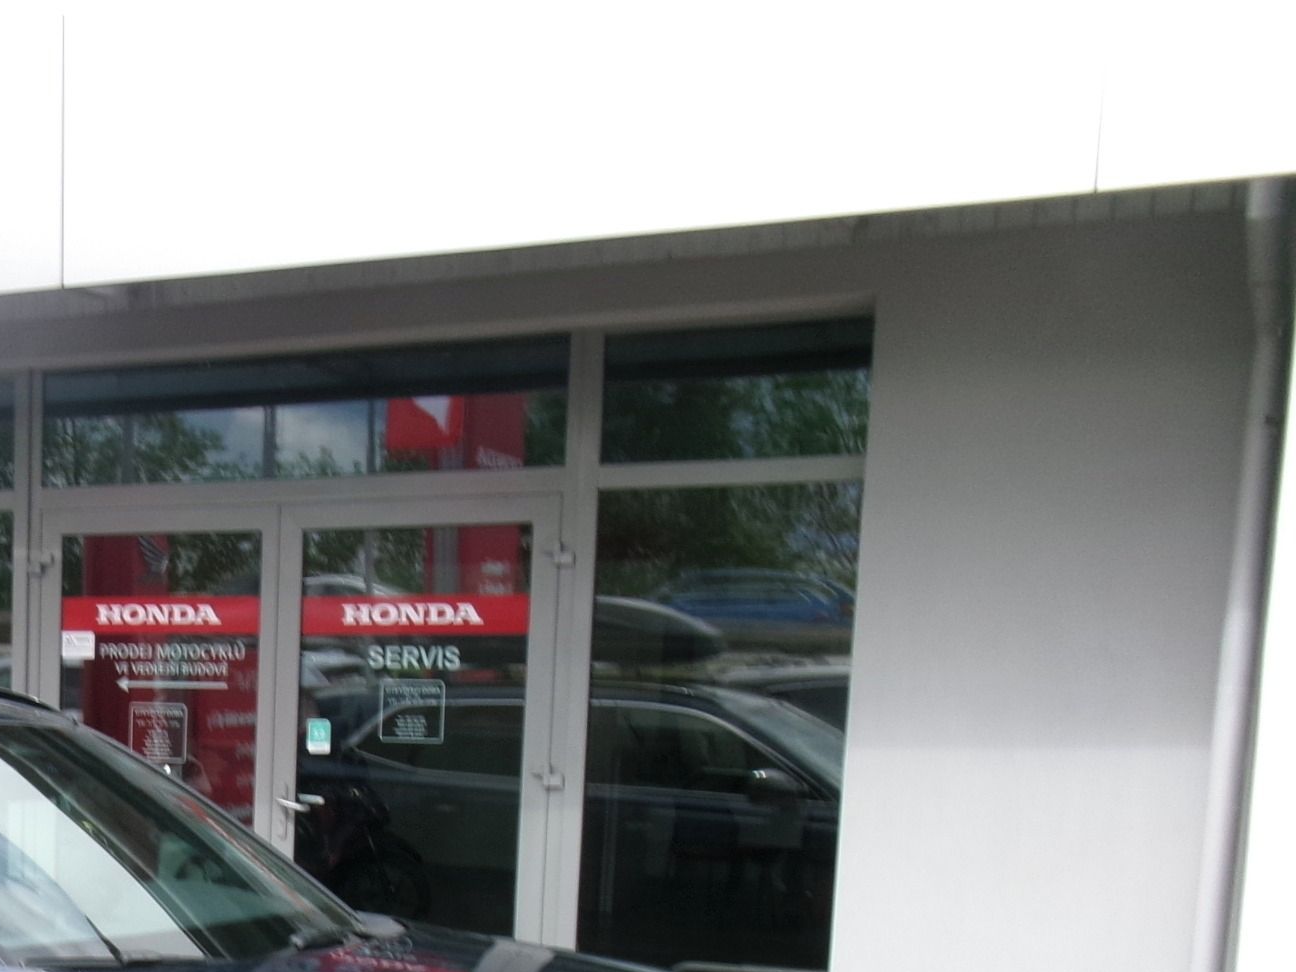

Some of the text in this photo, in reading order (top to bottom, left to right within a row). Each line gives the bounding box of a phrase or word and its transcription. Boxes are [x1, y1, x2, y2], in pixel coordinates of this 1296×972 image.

[95, 603, 222, 626] HONDA
[341, 601, 484, 626] HONDA
[99, 642, 153, 660] PRODEJ
[156, 638, 246, 661] MOTOCYKLŮ
[367, 644, 462, 670] SERVIS
[114, 661, 129, 675] VE
